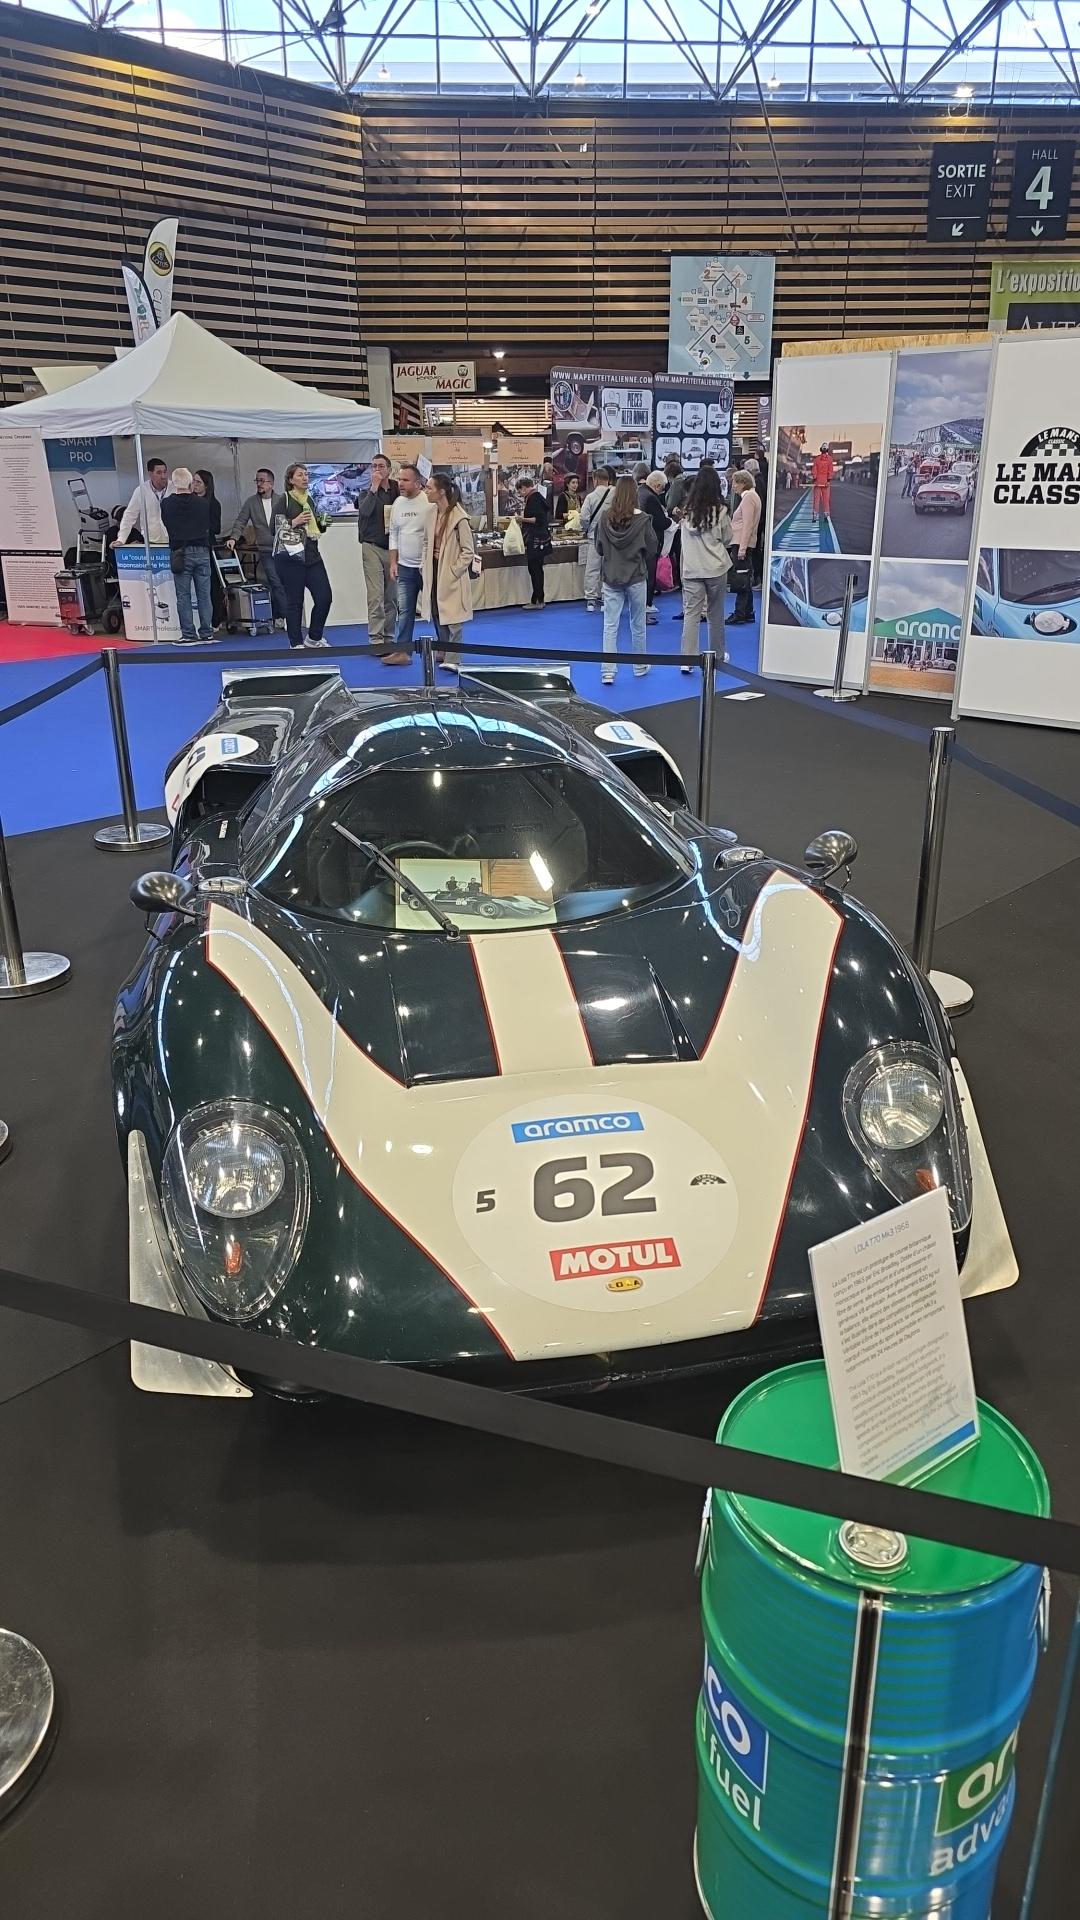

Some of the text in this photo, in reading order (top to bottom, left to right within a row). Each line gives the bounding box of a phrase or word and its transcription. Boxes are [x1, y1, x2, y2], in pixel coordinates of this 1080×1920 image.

[1031, 149, 1058, 160] HALL
[937, 164, 986, 178] SORTIE
[945, 184, 976, 198] EXIT
[1025, 166, 1053, 209] 4
[703, 269, 711, 279] 2
[742, 296, 748, 305] 4
[710, 335, 716, 343] 6
[744, 336, 750, 344] 5
[698, 350, 704, 358] 7
[396, 365, 437, 378] JAGUAR
[552, 371, 653, 384] WWW.MAPETITEITALIENNE.COM
[435, 379, 471, 389] MAGIC
[655, 375, 734, 388] WWW.MAPETITEITALIENNE.COM
[1038, 428, 1079, 442] LE MANS
[59, 437, 97, 447] SMART
[70, 452, 93, 462] PRO
[995, 463, 1080, 482] LE MA
[524, 1114, 631, 1138] aramco
[533, 1152, 657, 1222] 62
[476, 1189, 496, 1213] 5
[559, 1242, 673, 1275] MOTUL
[709, 1734, 761, 1831] fuel
